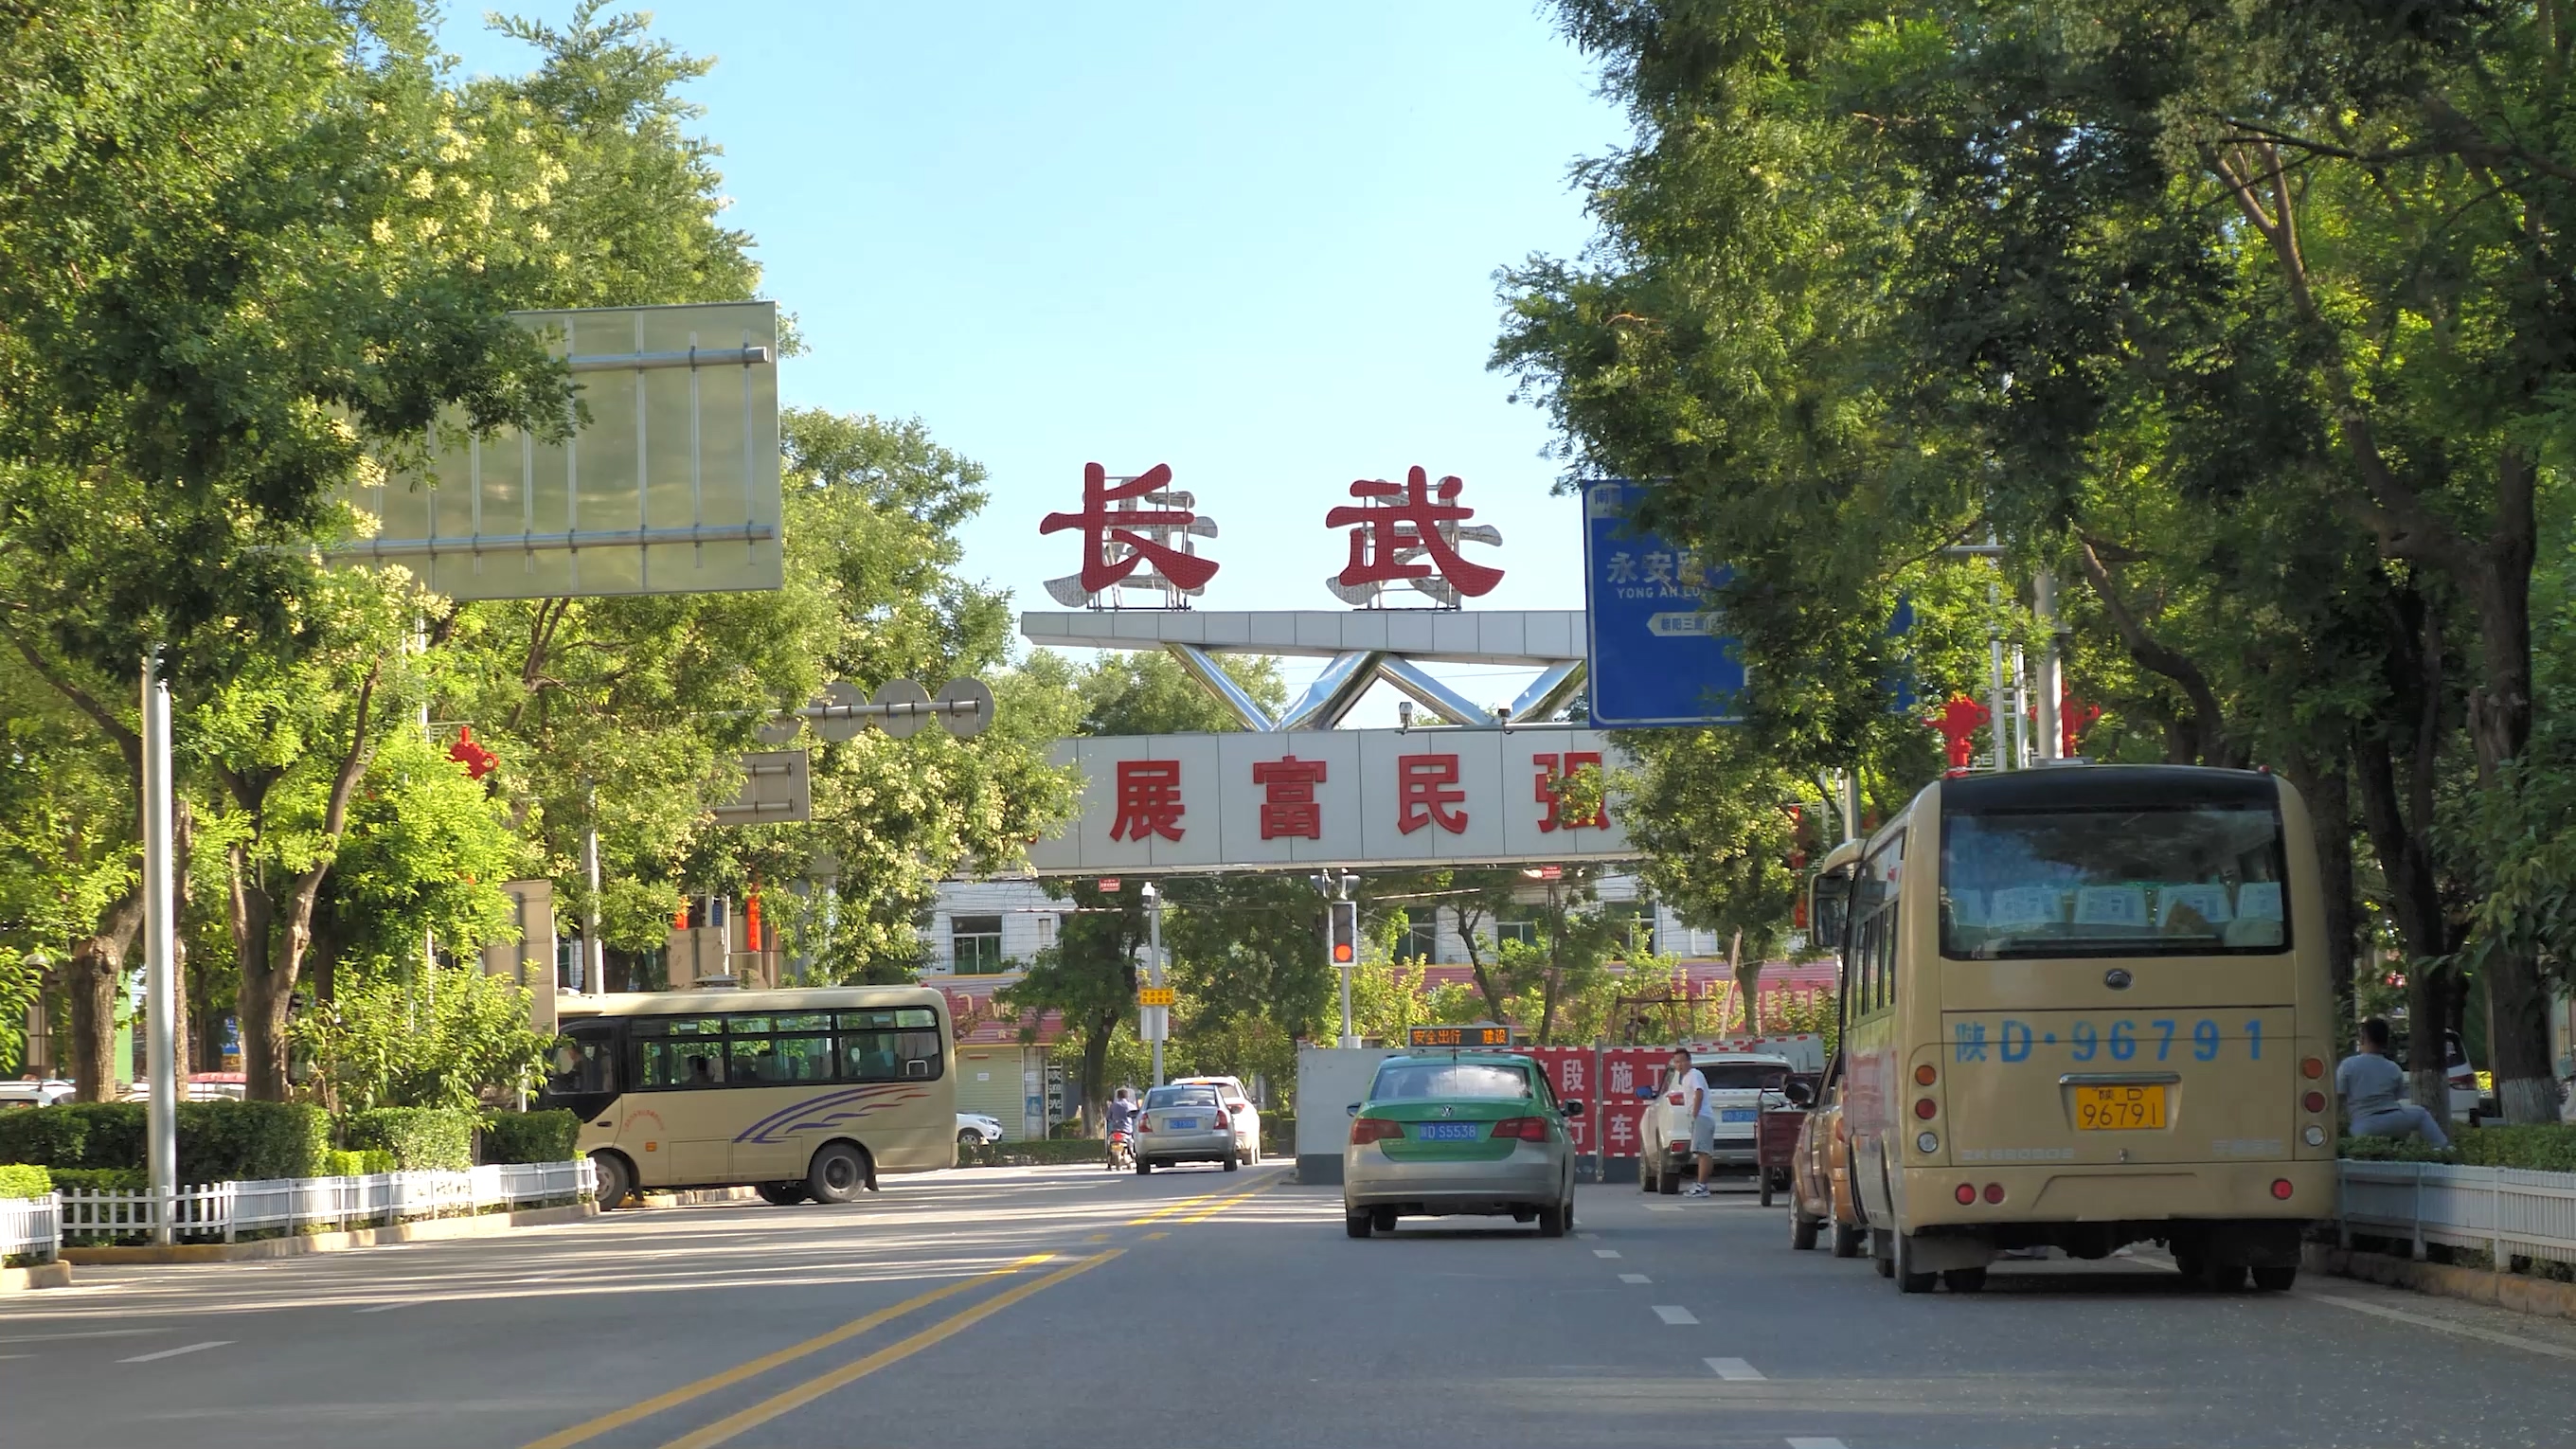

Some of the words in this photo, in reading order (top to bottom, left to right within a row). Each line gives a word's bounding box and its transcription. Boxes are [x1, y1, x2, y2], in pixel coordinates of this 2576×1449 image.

[1039, 461, 1505, 598] 长武
[1617, 587, 1655, 599] YONG
[1659, 587, 1678, 598] AN
[1683, 586, 1701, 598] LU
[1413, 1029, 1461, 1045] 安全出行
[1483, 1029, 1507, 1045] 建设
[1547, 1059, 1666, 1095] 段施工
[2083, 1103, 2158, 1126] 96791
